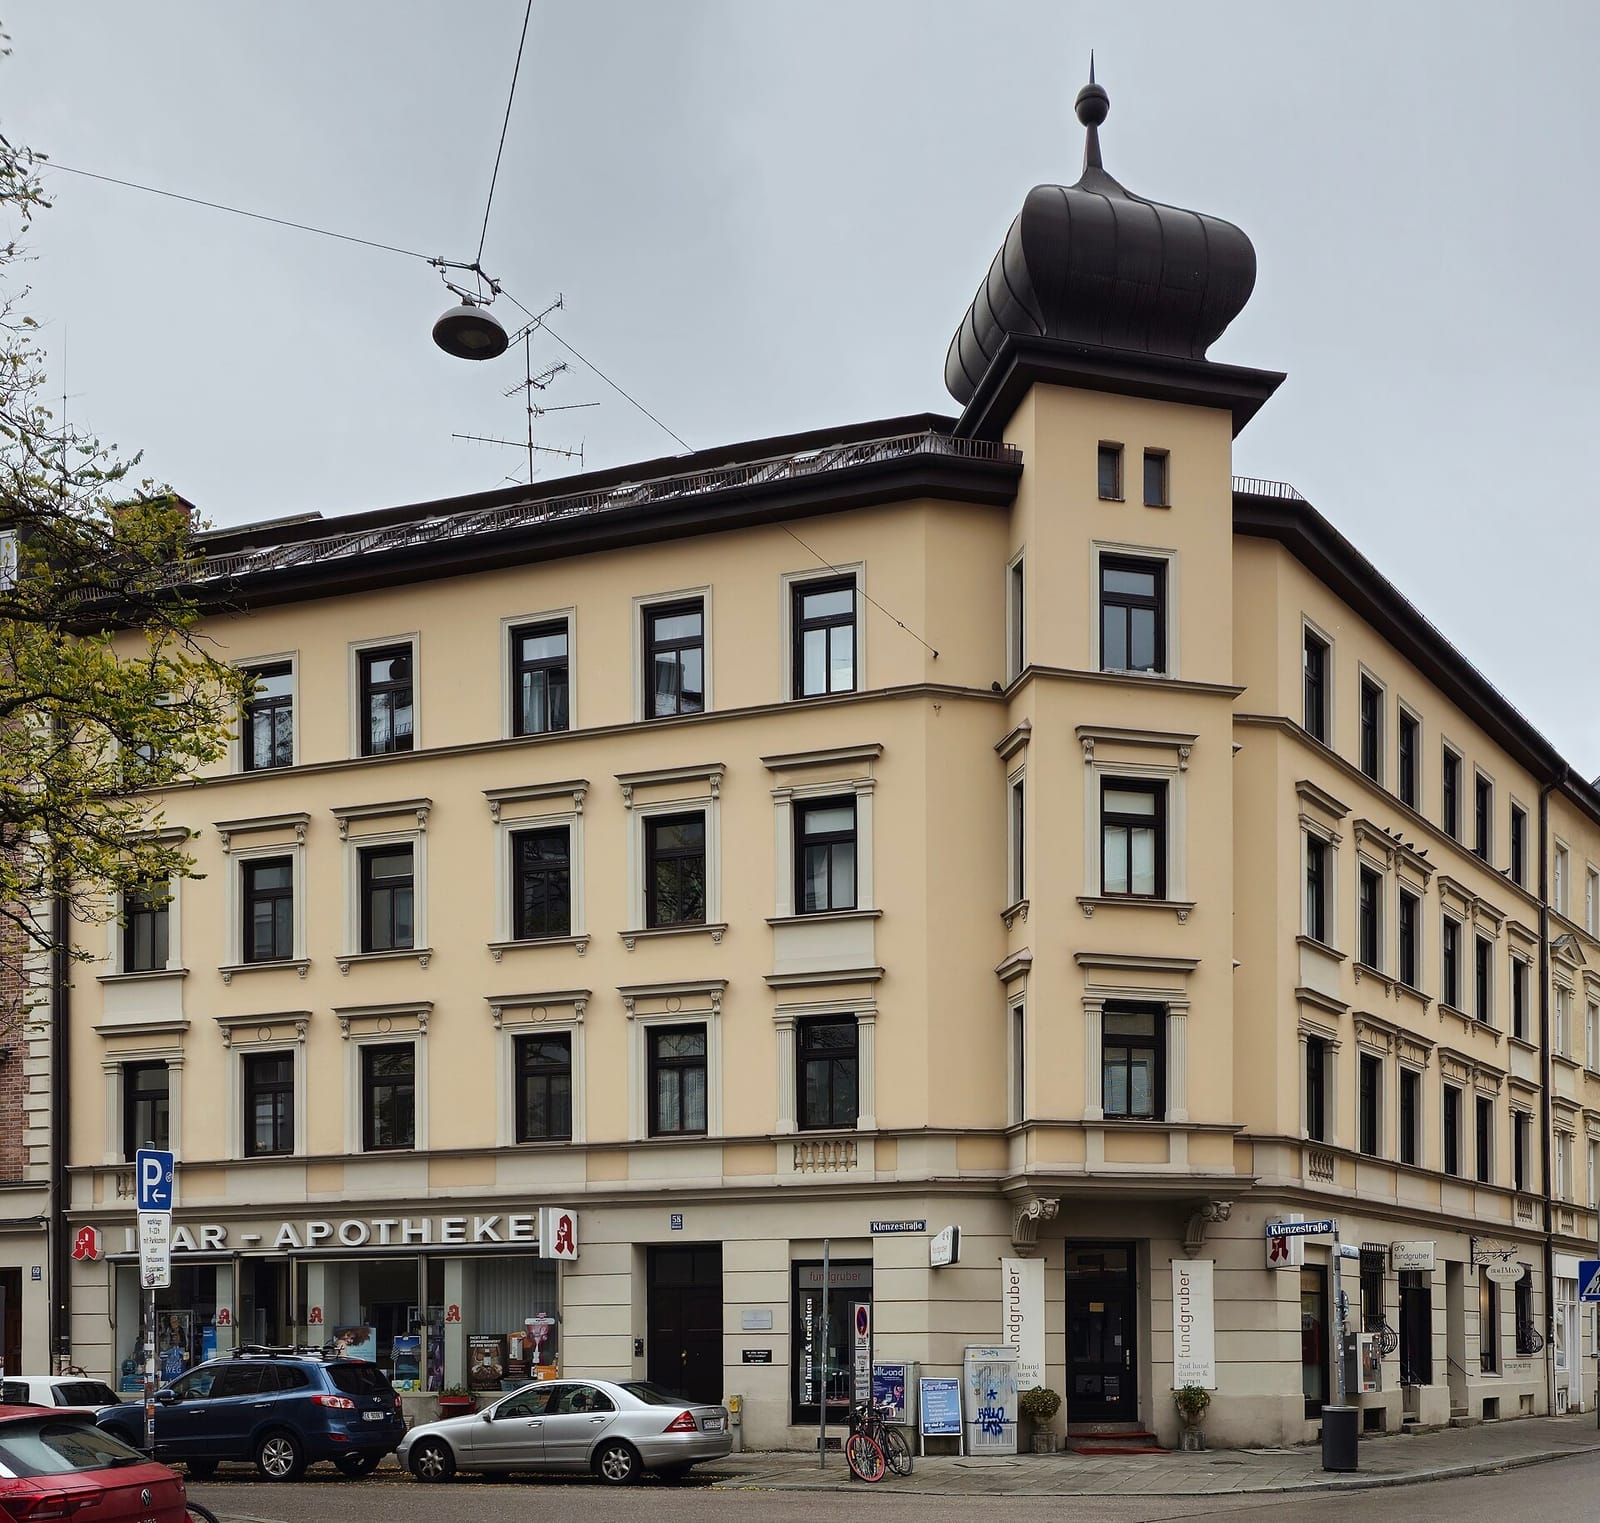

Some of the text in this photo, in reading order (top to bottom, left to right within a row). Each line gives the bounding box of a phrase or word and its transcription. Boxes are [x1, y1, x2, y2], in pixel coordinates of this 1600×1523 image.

[143, 1158, 163, 1203] P
[125, 1224, 229, 1251] IAR
[274, 1214, 536, 1249] APOTHEKE
[873, 1221, 923, 1231] Klenzestraße
[1270, 1222, 1329, 1236] Klenzestraße
[1177, 1270, 1193, 1358] fundgruber
[805, 1298, 813, 1401] 2nd hand & trachten
